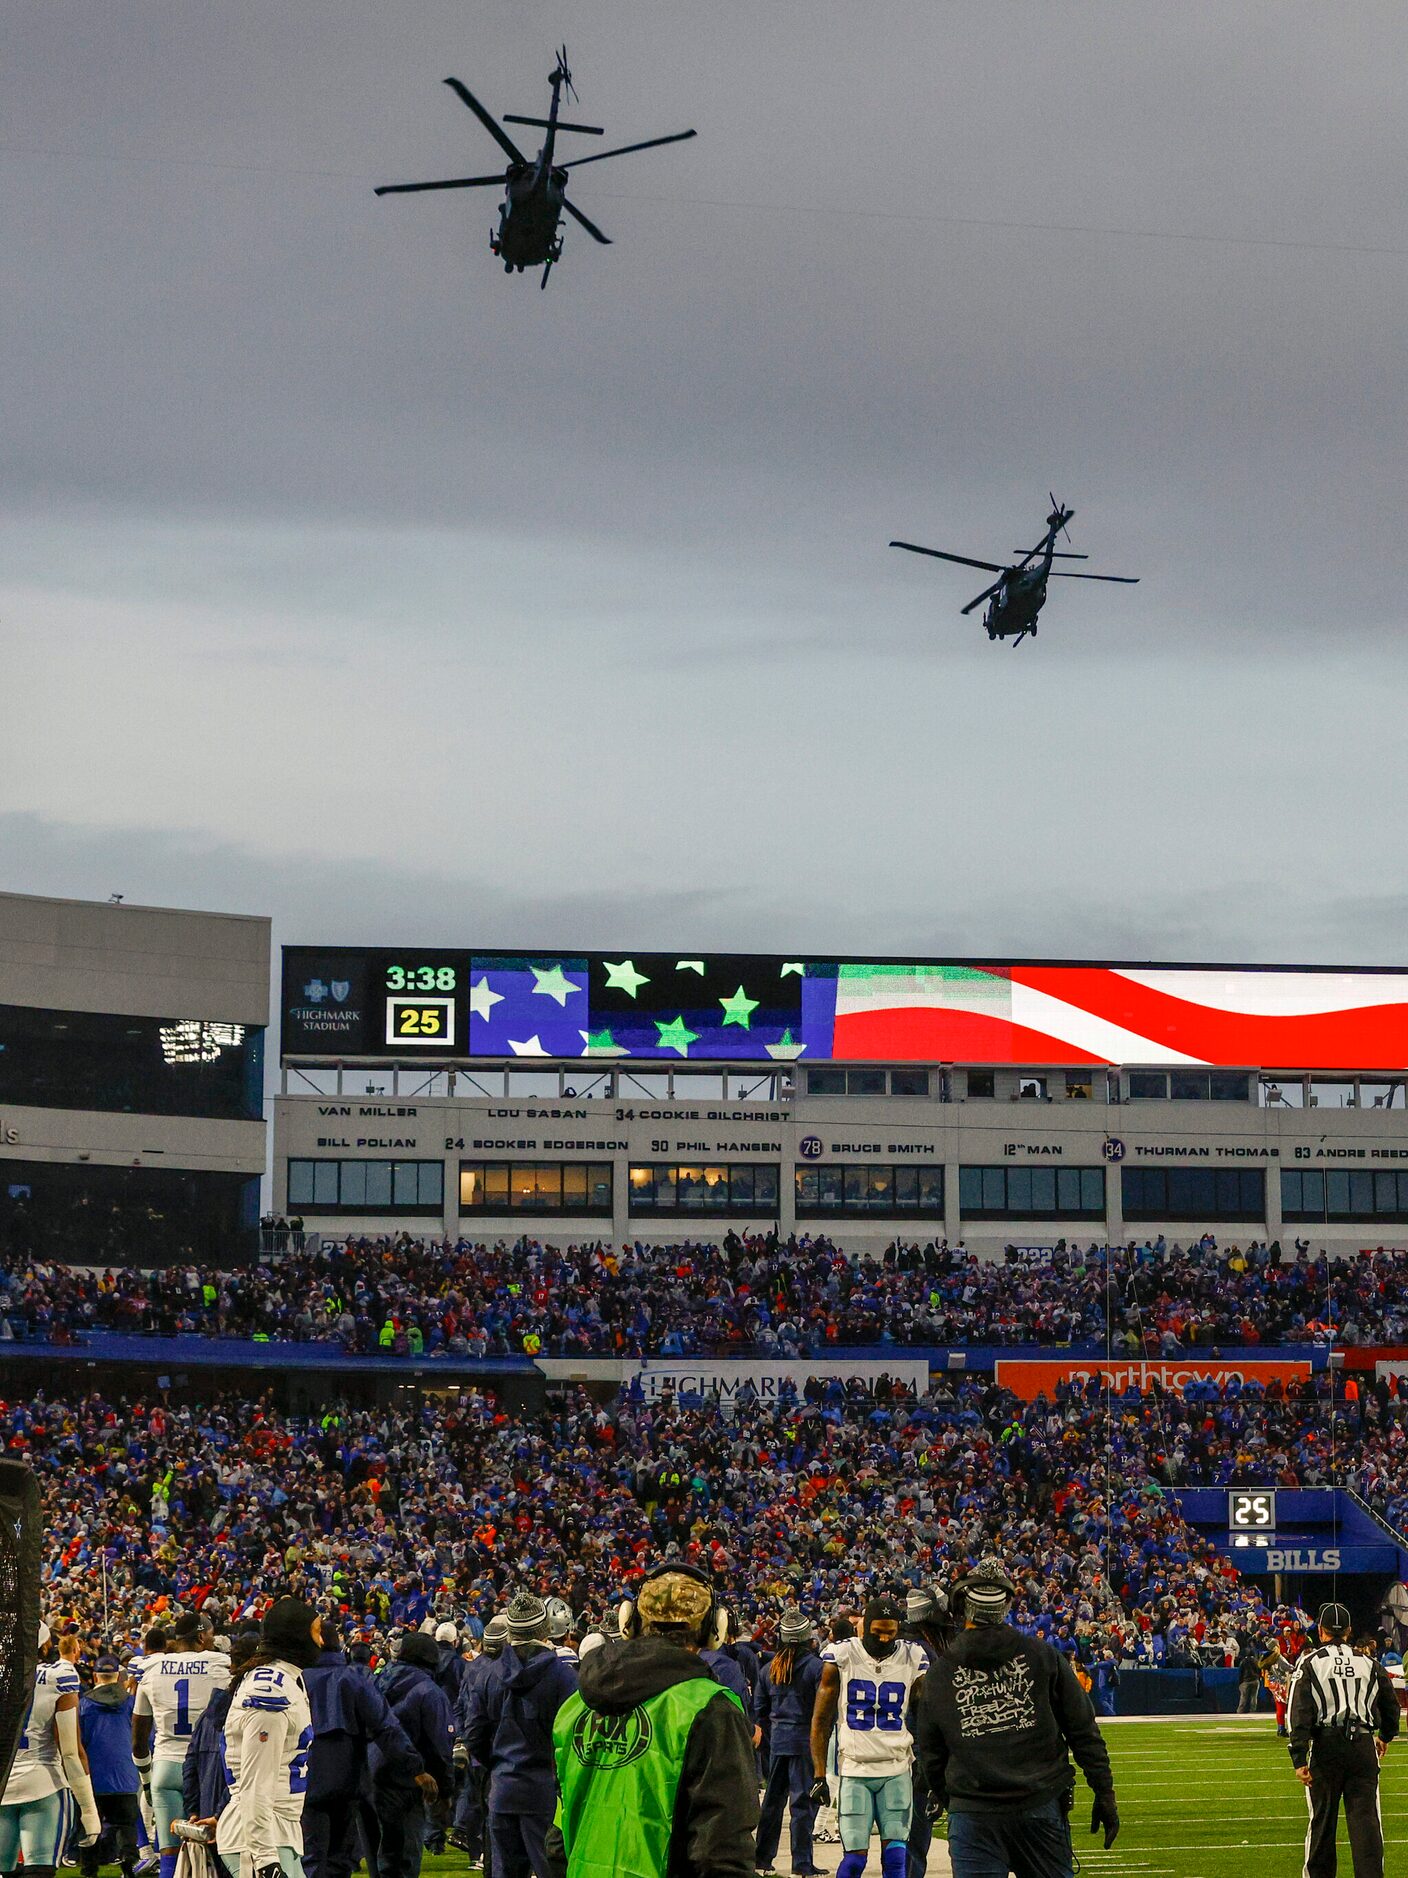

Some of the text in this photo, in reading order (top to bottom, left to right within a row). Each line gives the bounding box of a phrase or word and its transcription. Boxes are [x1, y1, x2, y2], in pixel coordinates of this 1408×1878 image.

[385, 965, 456, 991] 3:38
[297, 1010, 361, 1022] HIGHMARK
[400, 1009, 440, 1034] 25
[303, 1022, 350, 1031] STADIUM
[318, 1107, 417, 1117] VAN MILLER
[488, 1109, 587, 1119] LOU SABAN
[615, 1109, 790, 1121] 34 COOKIE GILCHRIST
[316, 1138, 417, 1148] BILL POLIAN
[445, 1137, 629, 1150] 24 BOOKER EDGERSON
[651, 1140, 782, 1152] 90 PHIL HANSEN
[803, 1140, 934, 1155] 78 BRUCE SMITH
[1104, 1141, 1279, 1158] 34 THURMAN THOMAS
[1027, 1145, 1063, 1155] MAN
[1294, 1146, 1310, 1159] 83
[1316, 1148, 1366, 1158] ANDRE
[1235, 1497, 1270, 1524] 25
[1266, 1549, 1341, 1572] BILLS
[160, 1660, 209, 1675] KEARSE
[1334, 1657, 1350, 1666] DJ
[253, 1667, 286, 1688] 21
[1334, 1666, 1355, 1677] 48
[174, 1678, 192, 1735] 1
[847, 1679, 906, 1731] 88
